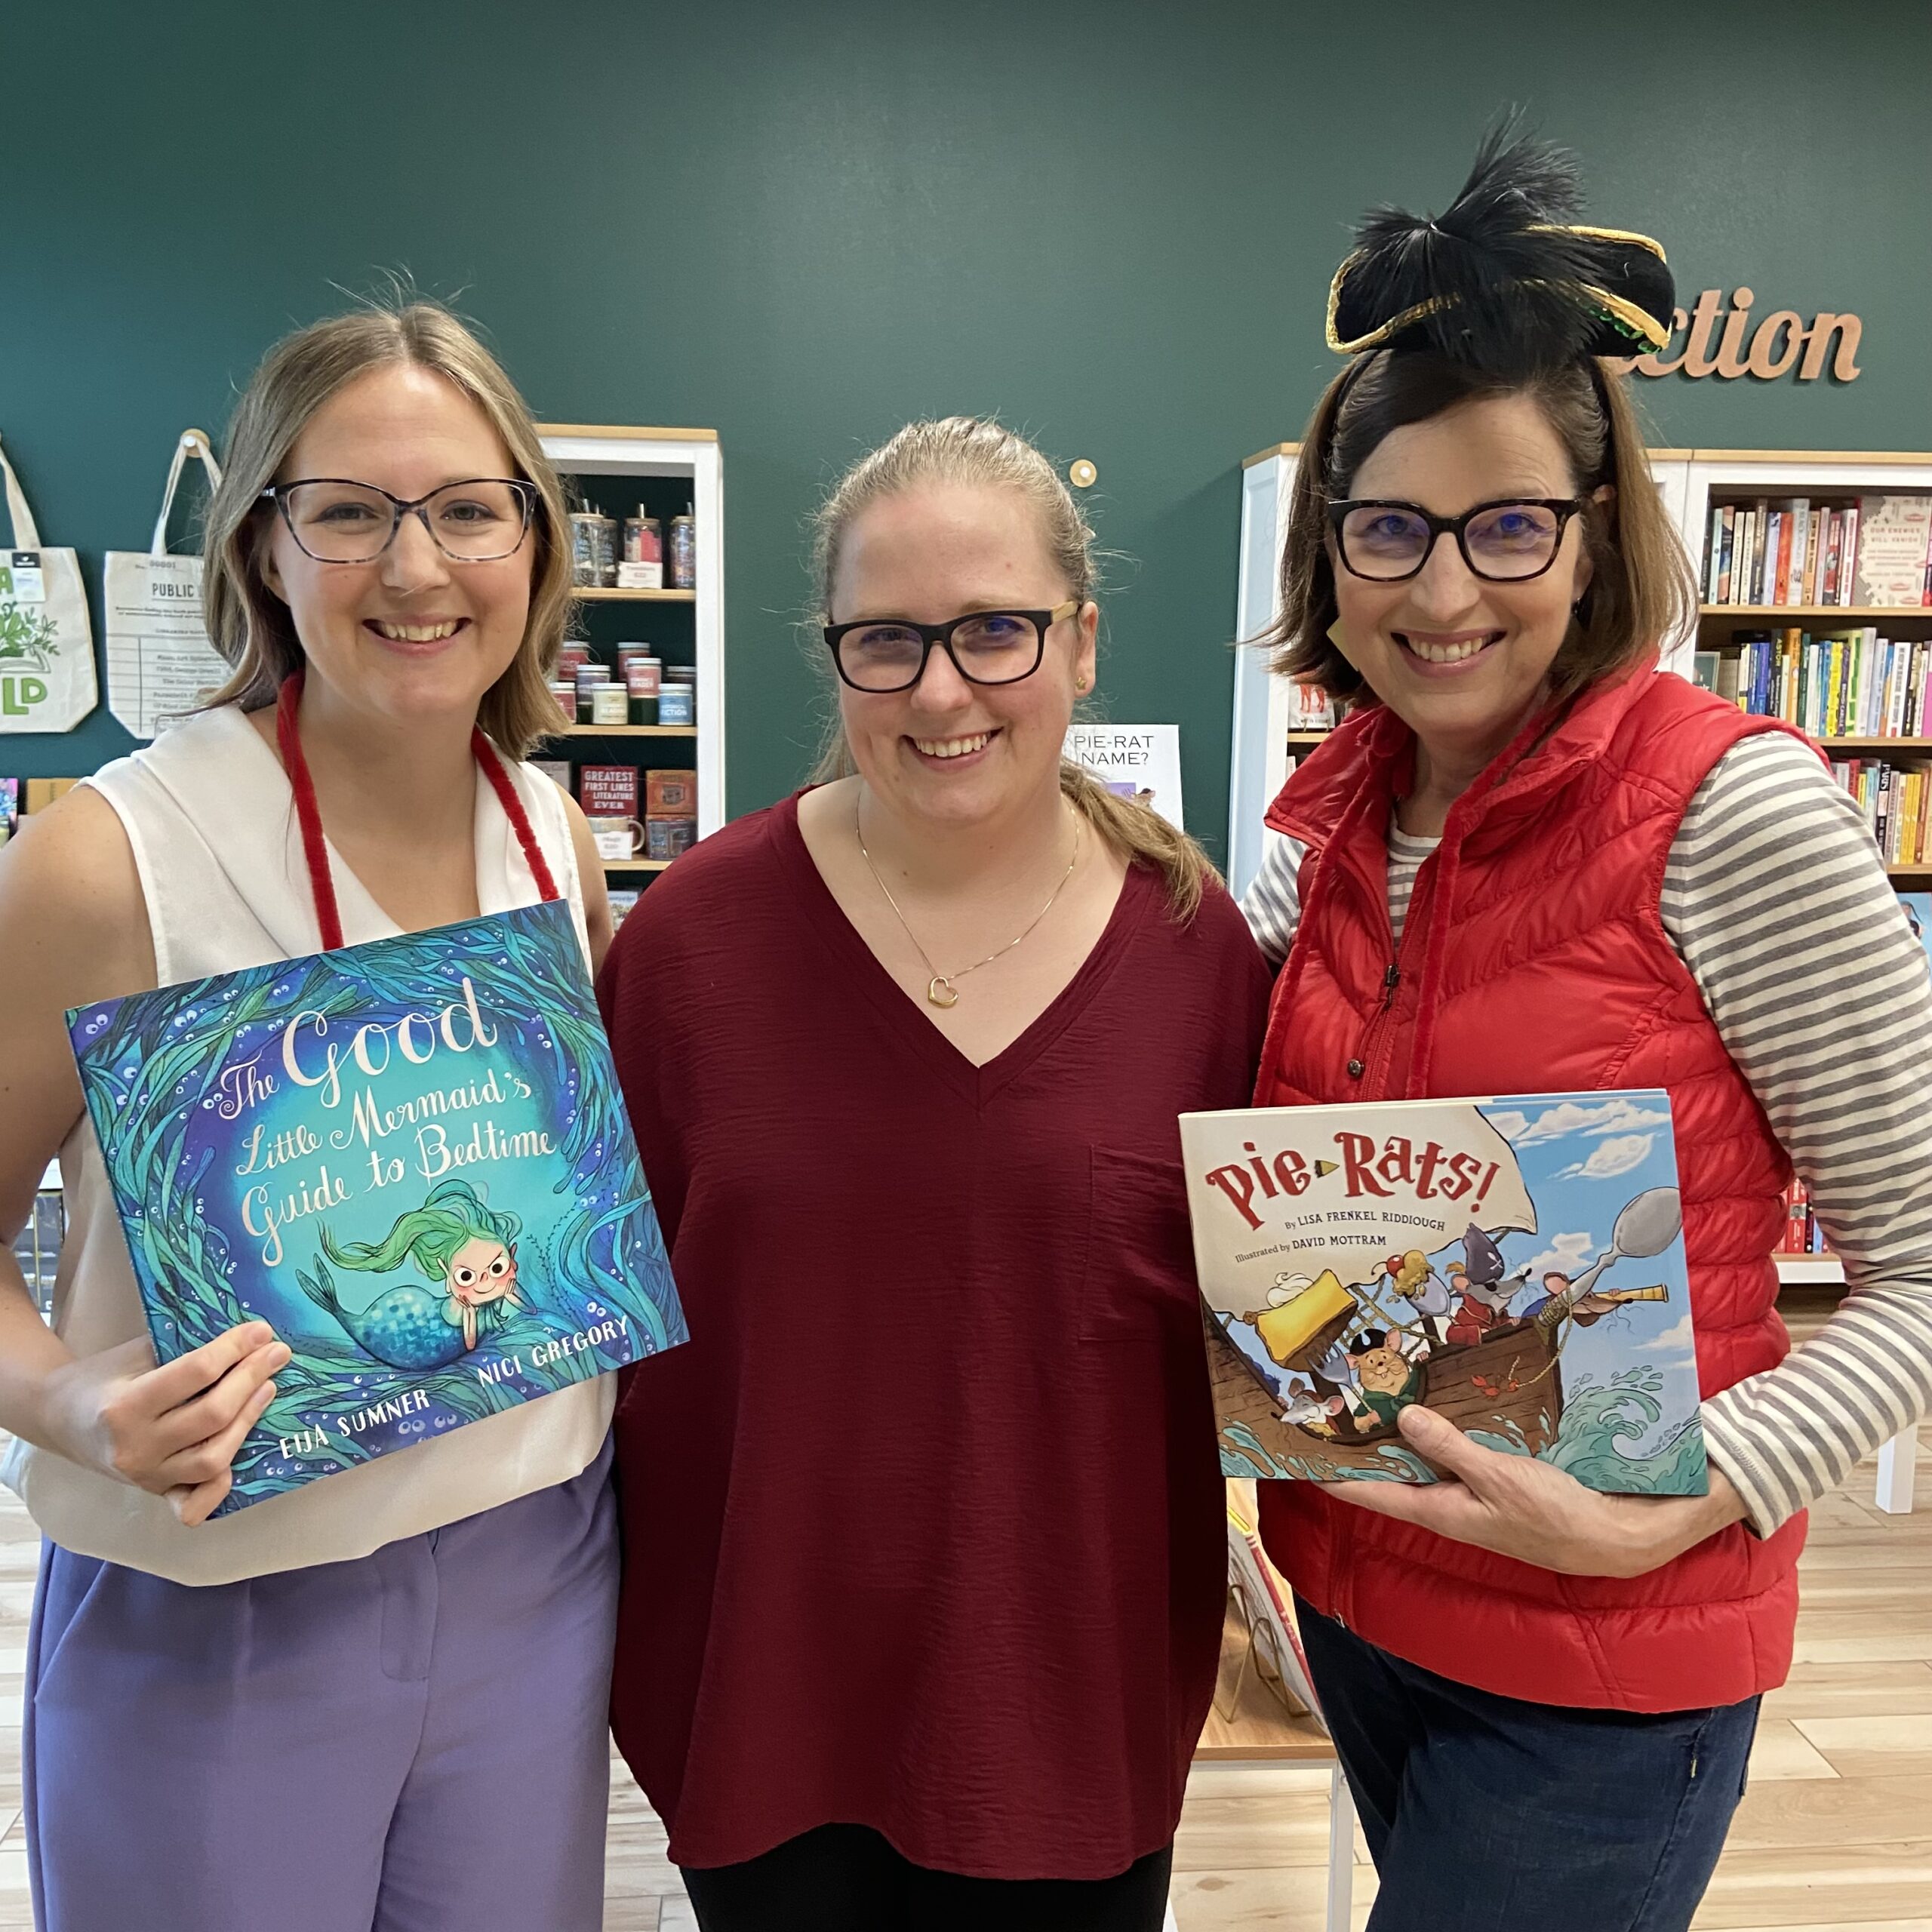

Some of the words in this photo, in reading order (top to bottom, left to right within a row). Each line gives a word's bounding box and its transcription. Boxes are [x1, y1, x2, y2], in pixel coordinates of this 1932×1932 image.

[1615, 286, 1862, 382] ction
[152, 583, 195, 597] PUBLIC
[3, 677, 48, 715] LD
[1074, 736, 1154, 748] PIE-RAT
[1081, 752, 1149, 765] NAME?
[585, 771, 633, 781] GREATEST
[585, 782, 608, 791] FIRST
[611, 783, 634, 792] LINES
[1881, 764, 1890, 790] PARIS
[593, 792, 634, 800] LITERATURE
[219, 1050, 279, 1119] The
[282, 977, 498, 1108] Good
[235, 1124, 322, 1176] Little
[330, 1069, 531, 1149] Mermaid's
[1333, 1131, 1502, 1214] Rats!
[242, 1165, 352, 1266] Guide
[363, 1151, 405, 1192] to
[414, 1120, 557, 1186] Bedtime
[1284, 1220, 1297, 1230] By
[1297, 1212, 1323, 1226] LISA
[1327, 1210, 1378, 1223] FRENKEL
[1382, 1211, 1446, 1232] RIDDIOUGH
[1235, 1244, 1279, 1264] Illustrated
[1279, 1242, 1291, 1253] by
[1292, 1235, 1325, 1250] DAVID
[1330, 1234, 1388, 1246] MOTTRAM
[477, 1354, 523, 1388] NICI
[531, 1314, 629, 1367] GREGORY
[279, 1423, 329, 1460] EIJA
[337, 1389, 430, 1438] SUMNER
